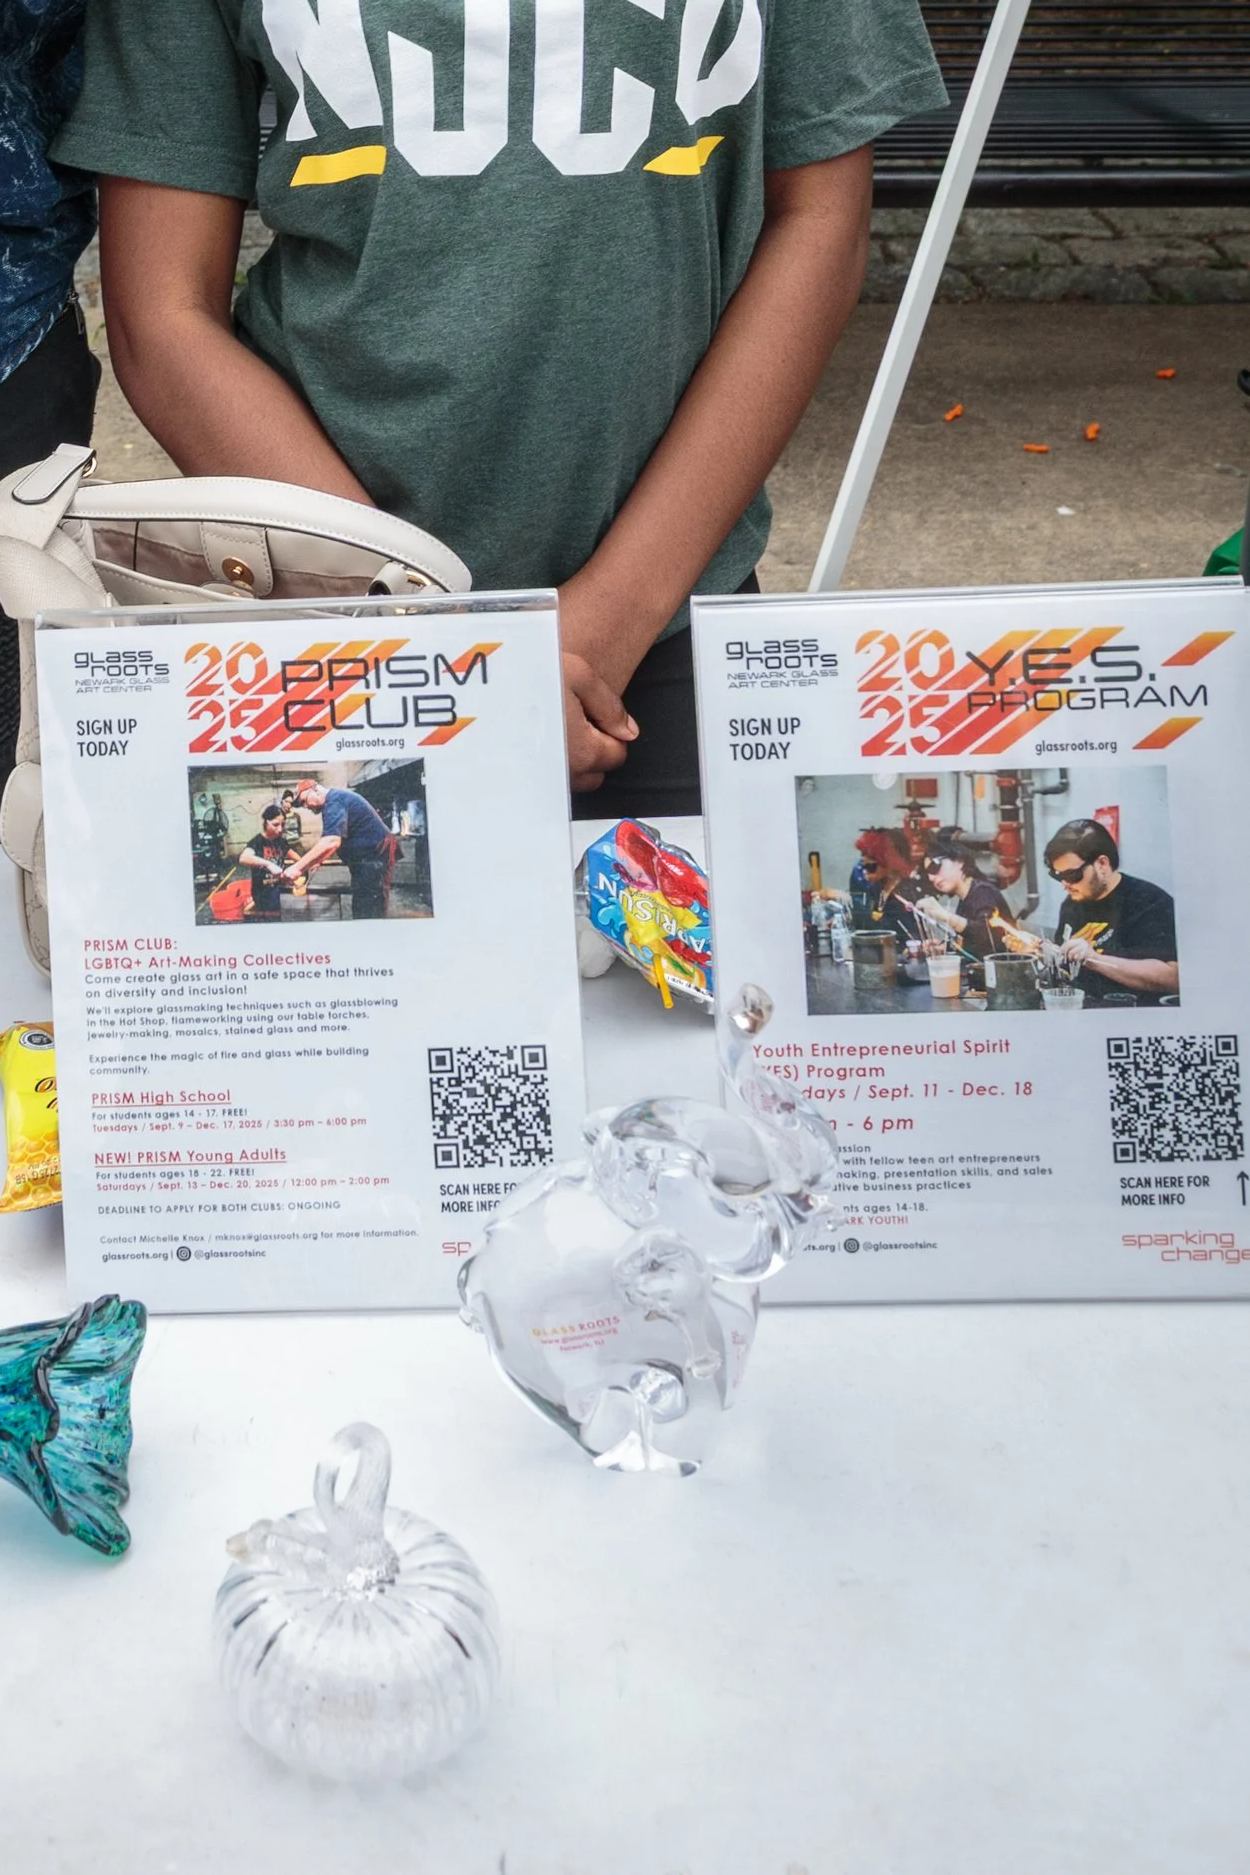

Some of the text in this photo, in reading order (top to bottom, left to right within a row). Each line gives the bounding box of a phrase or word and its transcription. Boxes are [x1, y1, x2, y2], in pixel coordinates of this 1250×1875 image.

[725, 638, 819, 659] glass
[73, 650, 155, 668] glass
[745, 653, 838, 668] roots
[854, 628, 954, 692] 20
[965, 645, 1157, 686] Y.E.S.
[90, 663, 169, 677] roots
[184, 641, 269, 697] 20
[280, 651, 488, 693] PRISM
[727, 668, 838, 680] NEWARK GLASS
[74, 676, 170, 686] NEWARK GLASS
[75, 684, 152, 694] ART CENTER
[728, 678, 818, 689] ART CENTER
[967, 684, 1208, 714] PROGRAM
[284, 694, 458, 733] CLUB
[76, 718, 137, 736] SIGN UP
[188, 698, 258, 753] 25
[729, 717, 800, 736] SIGN UP
[859, 694, 951, 757] 25
[76, 740, 128, 757] TODAY
[335, 737, 404, 751] glassroots.org
[729, 741, 790, 760] TODAY
[1035, 739, 1117, 756] glassroots.org
[84, 937, 177, 951] PRISM CLUB:
[84, 952, 330, 969] LGBTQ+ Art-Making Collectives
[84, 966, 393, 984] Come create glass art in a safe space that thrives
[85, 984, 246, 998] on diversity and inclusion!
[752, 1039, 1010, 1059] Youth Entrepreneurial Spirit
[806, 1064, 885, 1081] Program
[92, 1089, 230, 1104] PRISM High School
[868, 1083, 913, 1101] Sept.
[923, 1083, 937, 1097] 11
[962, 1082, 1004, 1096] Dec.
[1015, 1081, 1032, 1095] 18
[862, 1115, 873, 1131] 6
[881, 1118, 913, 1133] pm
[94, 1148, 285, 1164] NEW! PRISM Young Adults
[842, 1154, 1040, 1165] with fellow teen art entrepreneurs
[836, 1166, 1052, 1180] aking, presentation skills, and sales
[439, 1183, 469, 1196] SCAN
[472, 1182, 501, 1195] HERE
[863, 1180, 971, 1192] business practices
[1119, 1175, 1209, 1189] SCAN HERE FOR
[97, 1200, 341, 1214] DEADLINE TO APPLY FOR BOTH CLUBS: ONGOING
[441, 1200, 473, 1213] MORE
[1121, 1193, 1185, 1205] MORE INFO
[862, 1202, 928, 1214] ages 14-18.
[867, 1215, 908, 1225] YOUTH!
[1122, 1230, 1235, 1249] sparking
[101, 1251, 168, 1263] glassroots.org
